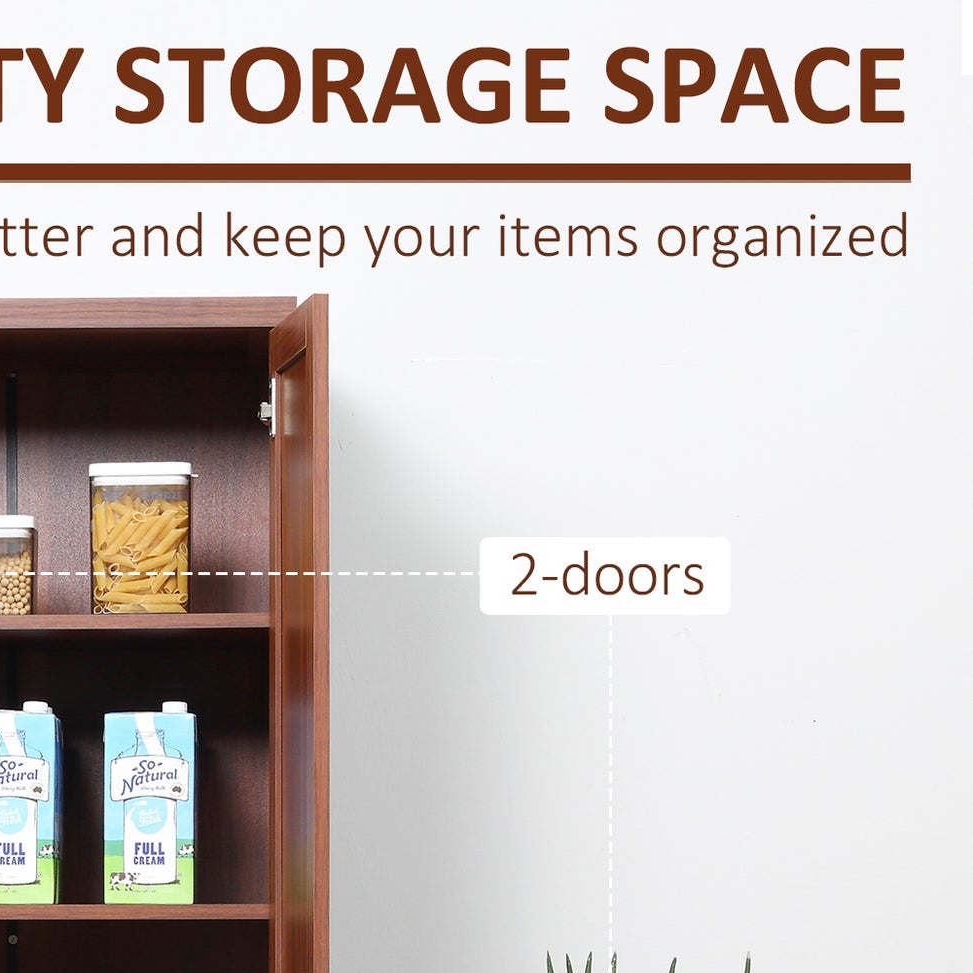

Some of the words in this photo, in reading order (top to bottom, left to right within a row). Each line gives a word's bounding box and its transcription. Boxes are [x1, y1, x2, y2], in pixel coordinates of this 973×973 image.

[120, 768, 177, 796] Natural
[134, 842, 165, 856] FULL
[133, 857, 165, 866] CREAM
